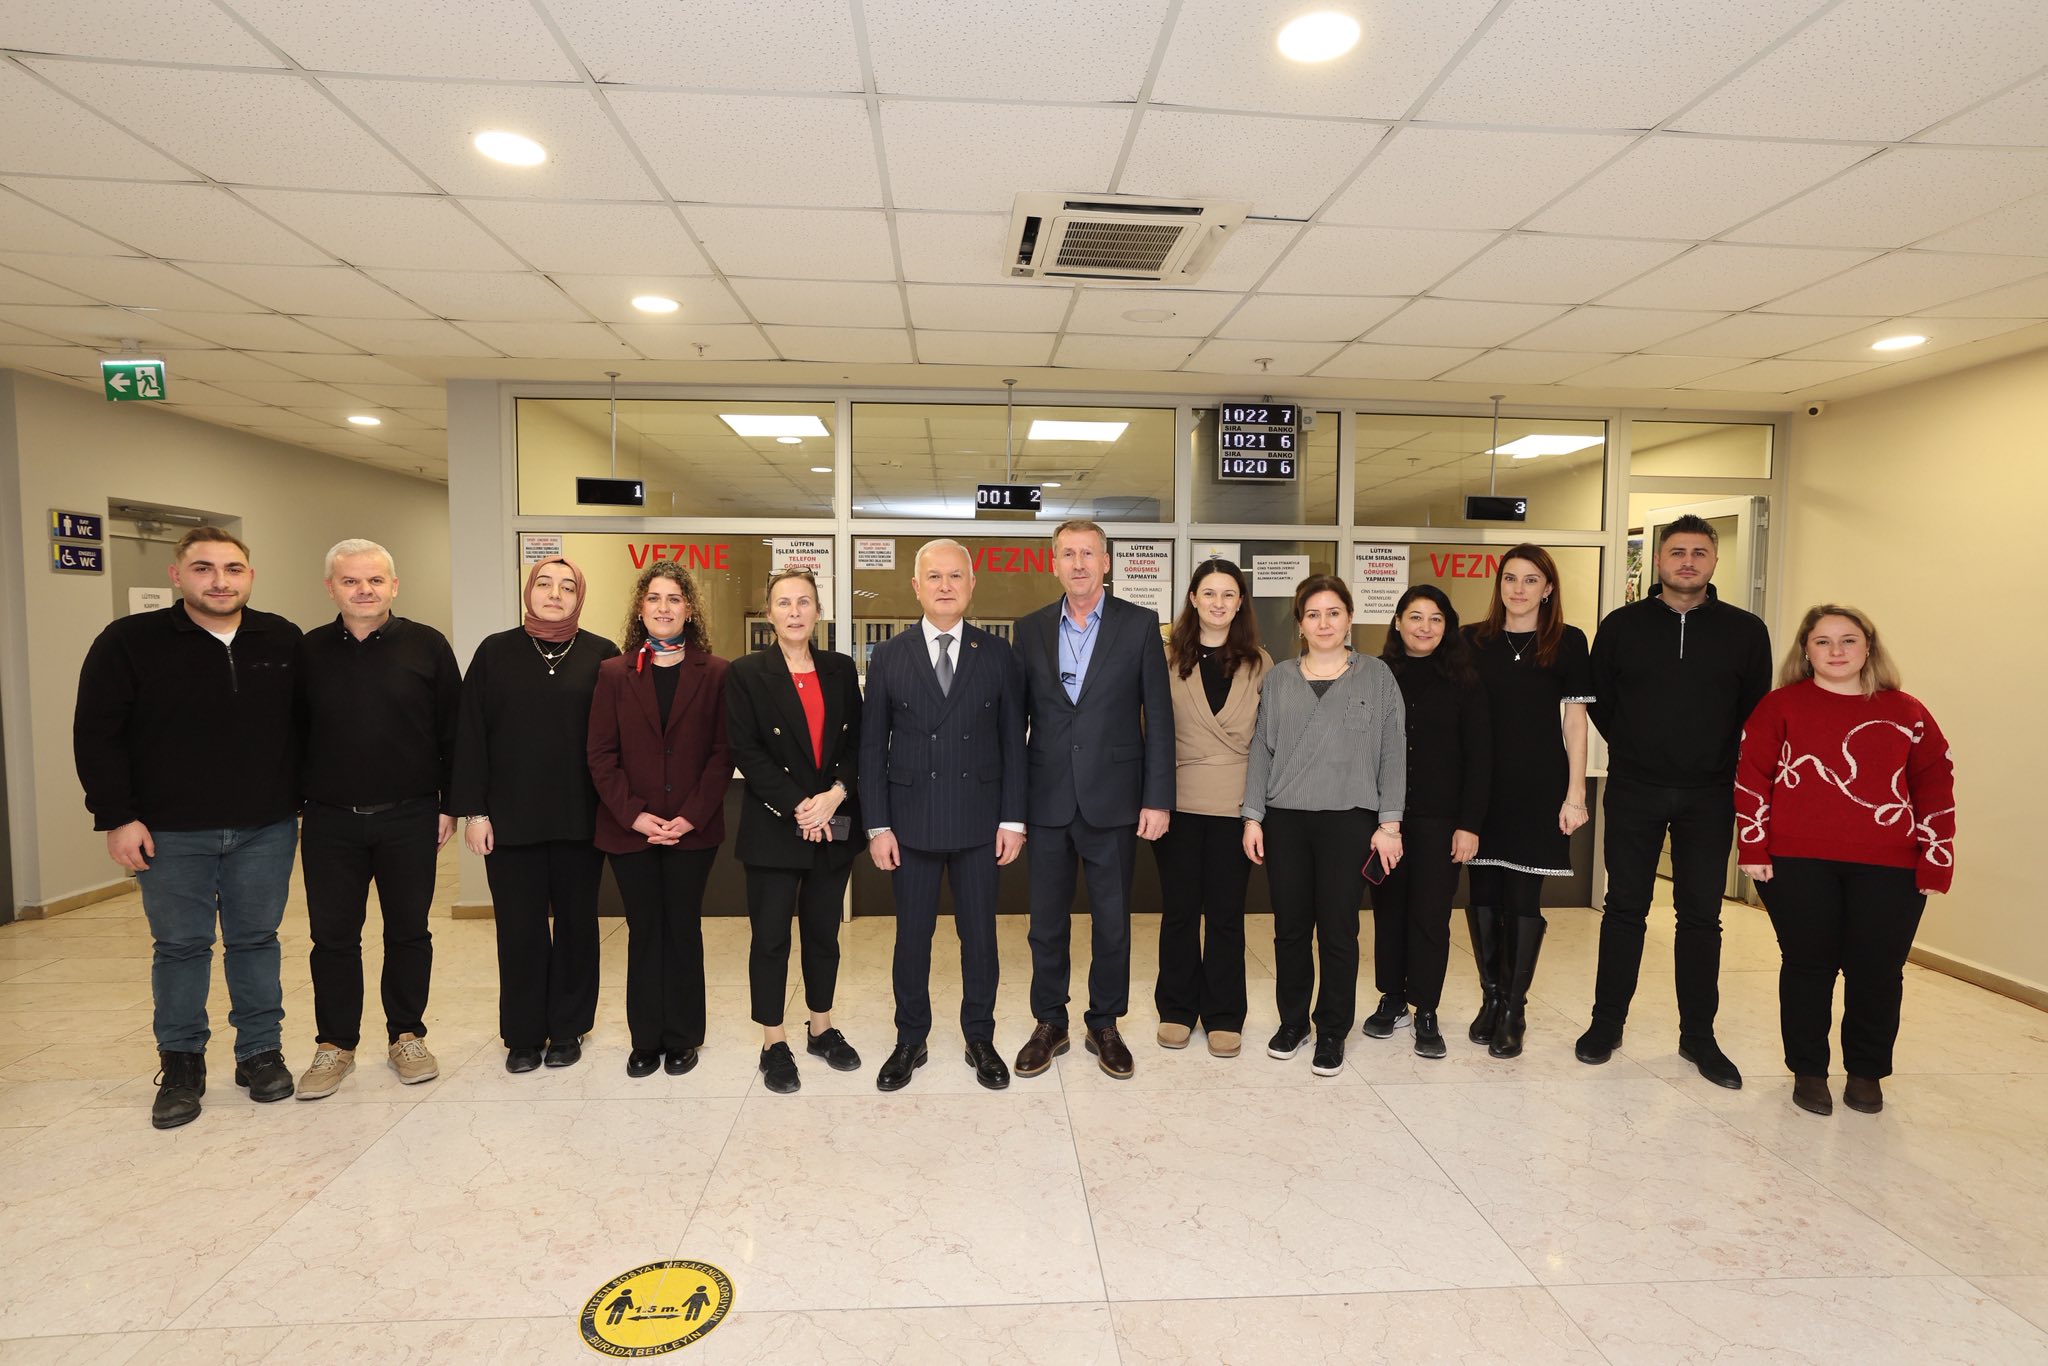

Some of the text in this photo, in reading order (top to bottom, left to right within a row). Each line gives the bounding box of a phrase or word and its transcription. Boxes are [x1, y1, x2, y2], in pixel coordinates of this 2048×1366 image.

[1224, 408, 1292, 423] 1022 7
[1224, 434, 1291, 448] 1021 6
[1223, 460, 1291, 474] 1020 6
[634, 485, 642, 498] 1
[978, 490, 1040, 504] 001 2
[1515, 501, 1526, 513] 3
[77, 525, 93, 536] WC
[80, 556, 96, 568] WC
[628, 544, 730, 570] VEZNE
[1430, 553, 1504, 578] VEZN
[612, 1264, 660, 1286] SOSYAL
[710, 1280, 730, 1322] KORUYUN
[589, 1331, 702, 1356] BURADA BEKLEYİN
